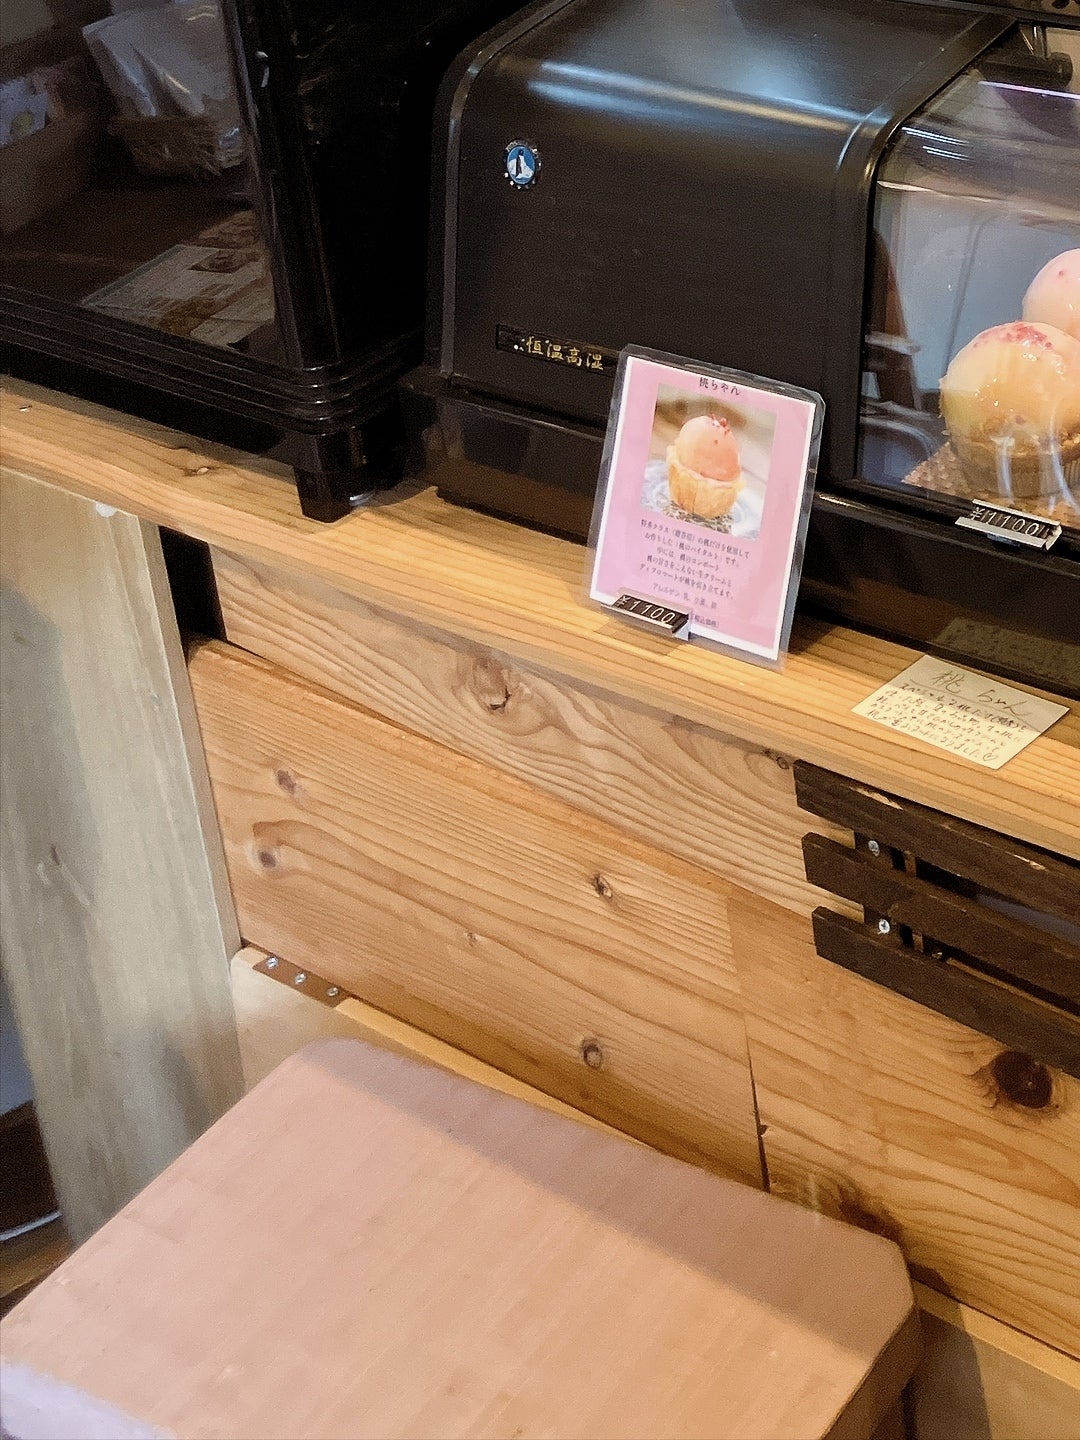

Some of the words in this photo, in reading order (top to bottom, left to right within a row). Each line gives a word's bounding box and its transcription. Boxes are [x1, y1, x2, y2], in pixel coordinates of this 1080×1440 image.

[700, 377, 740, 396] 桃ちゃん
[970, 506, 1039, 536] ¥1100
[617, 594, 676, 623] ¥1100
